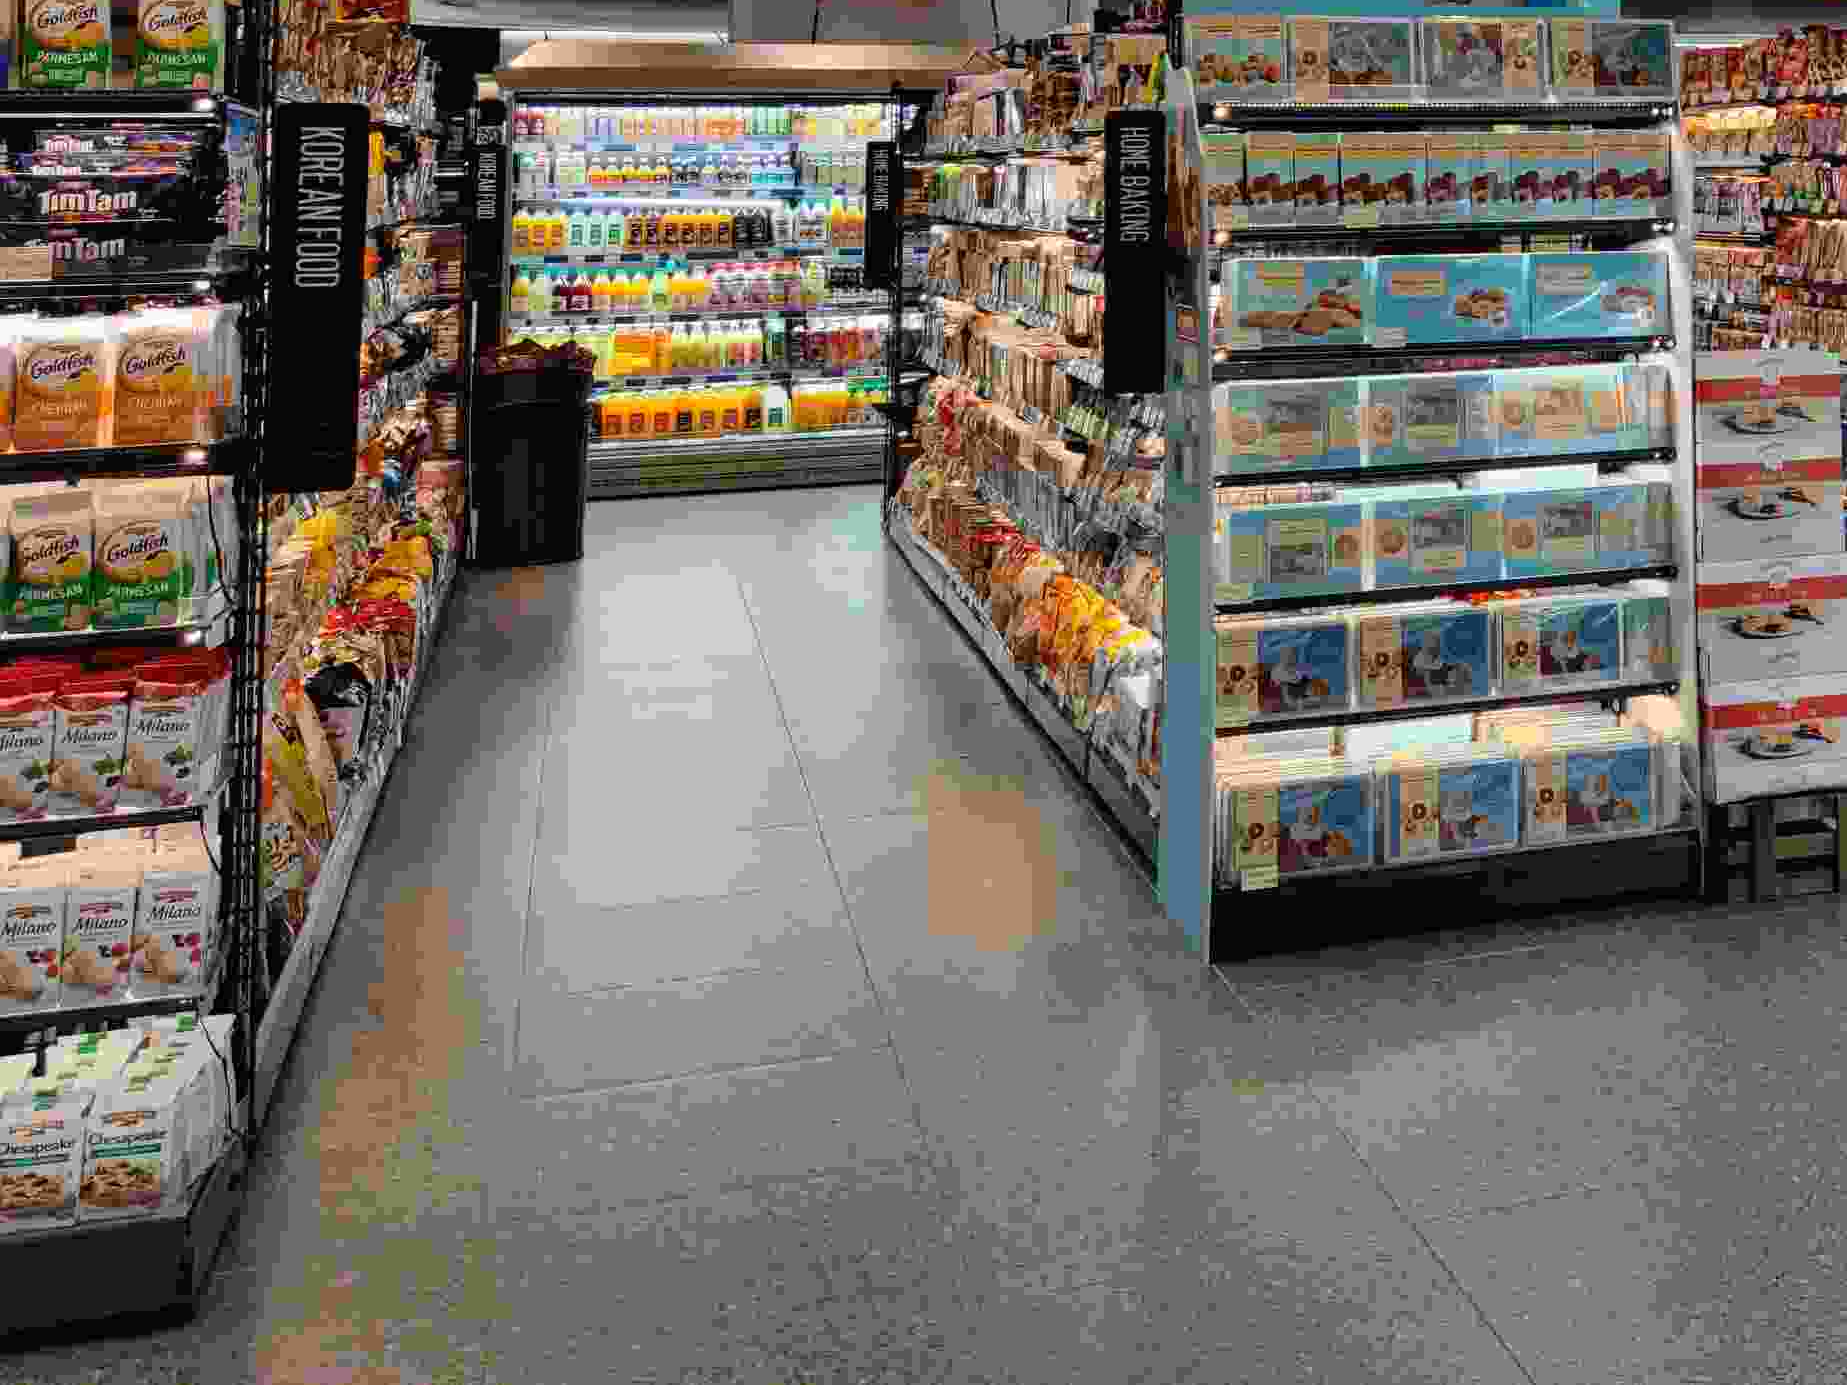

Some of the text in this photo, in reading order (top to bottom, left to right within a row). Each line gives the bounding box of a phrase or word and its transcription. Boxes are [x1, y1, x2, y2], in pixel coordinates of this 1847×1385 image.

[1119, 127, 1151, 243] HOME BAKING
[294, 126, 345, 288] KOREAN FOOD
[135, 717, 191, 736] Milano
[150, 902, 201, 921] Milano
[2, 921, 57, 938] Milano
[73, 917, 129, 934] Milano
